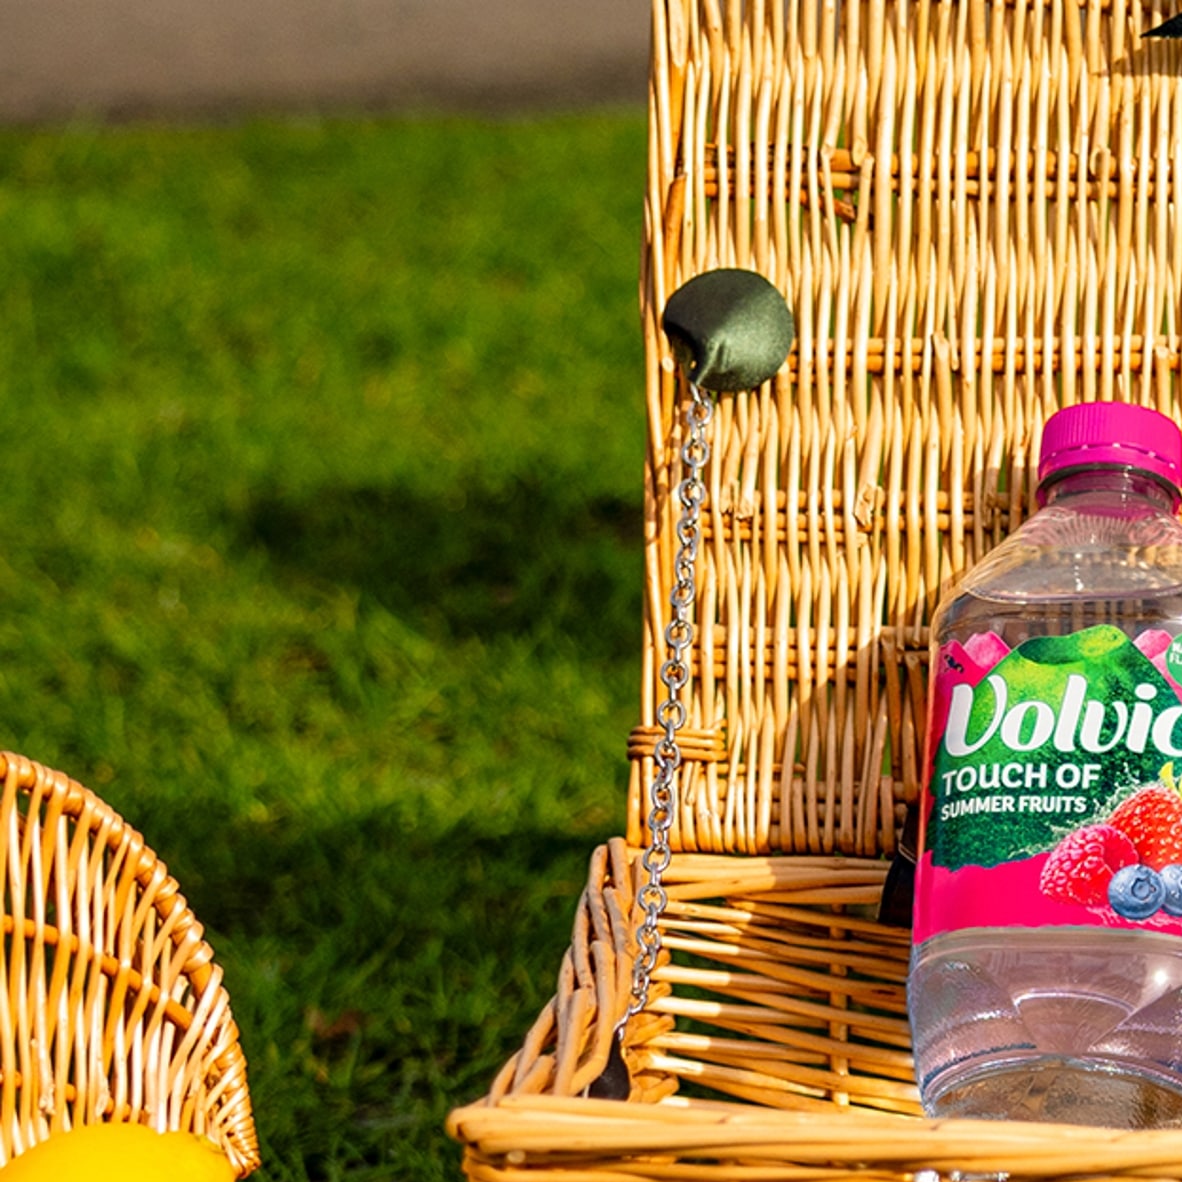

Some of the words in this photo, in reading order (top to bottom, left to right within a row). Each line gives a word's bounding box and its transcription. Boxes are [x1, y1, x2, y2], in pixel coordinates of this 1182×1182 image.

[942, 763, 1047, 796] TOUCH
[1055, 762, 1101, 788] OF
[941, 796, 1017, 821] SUMMER
[1019, 795, 1087, 814] FRUITS
